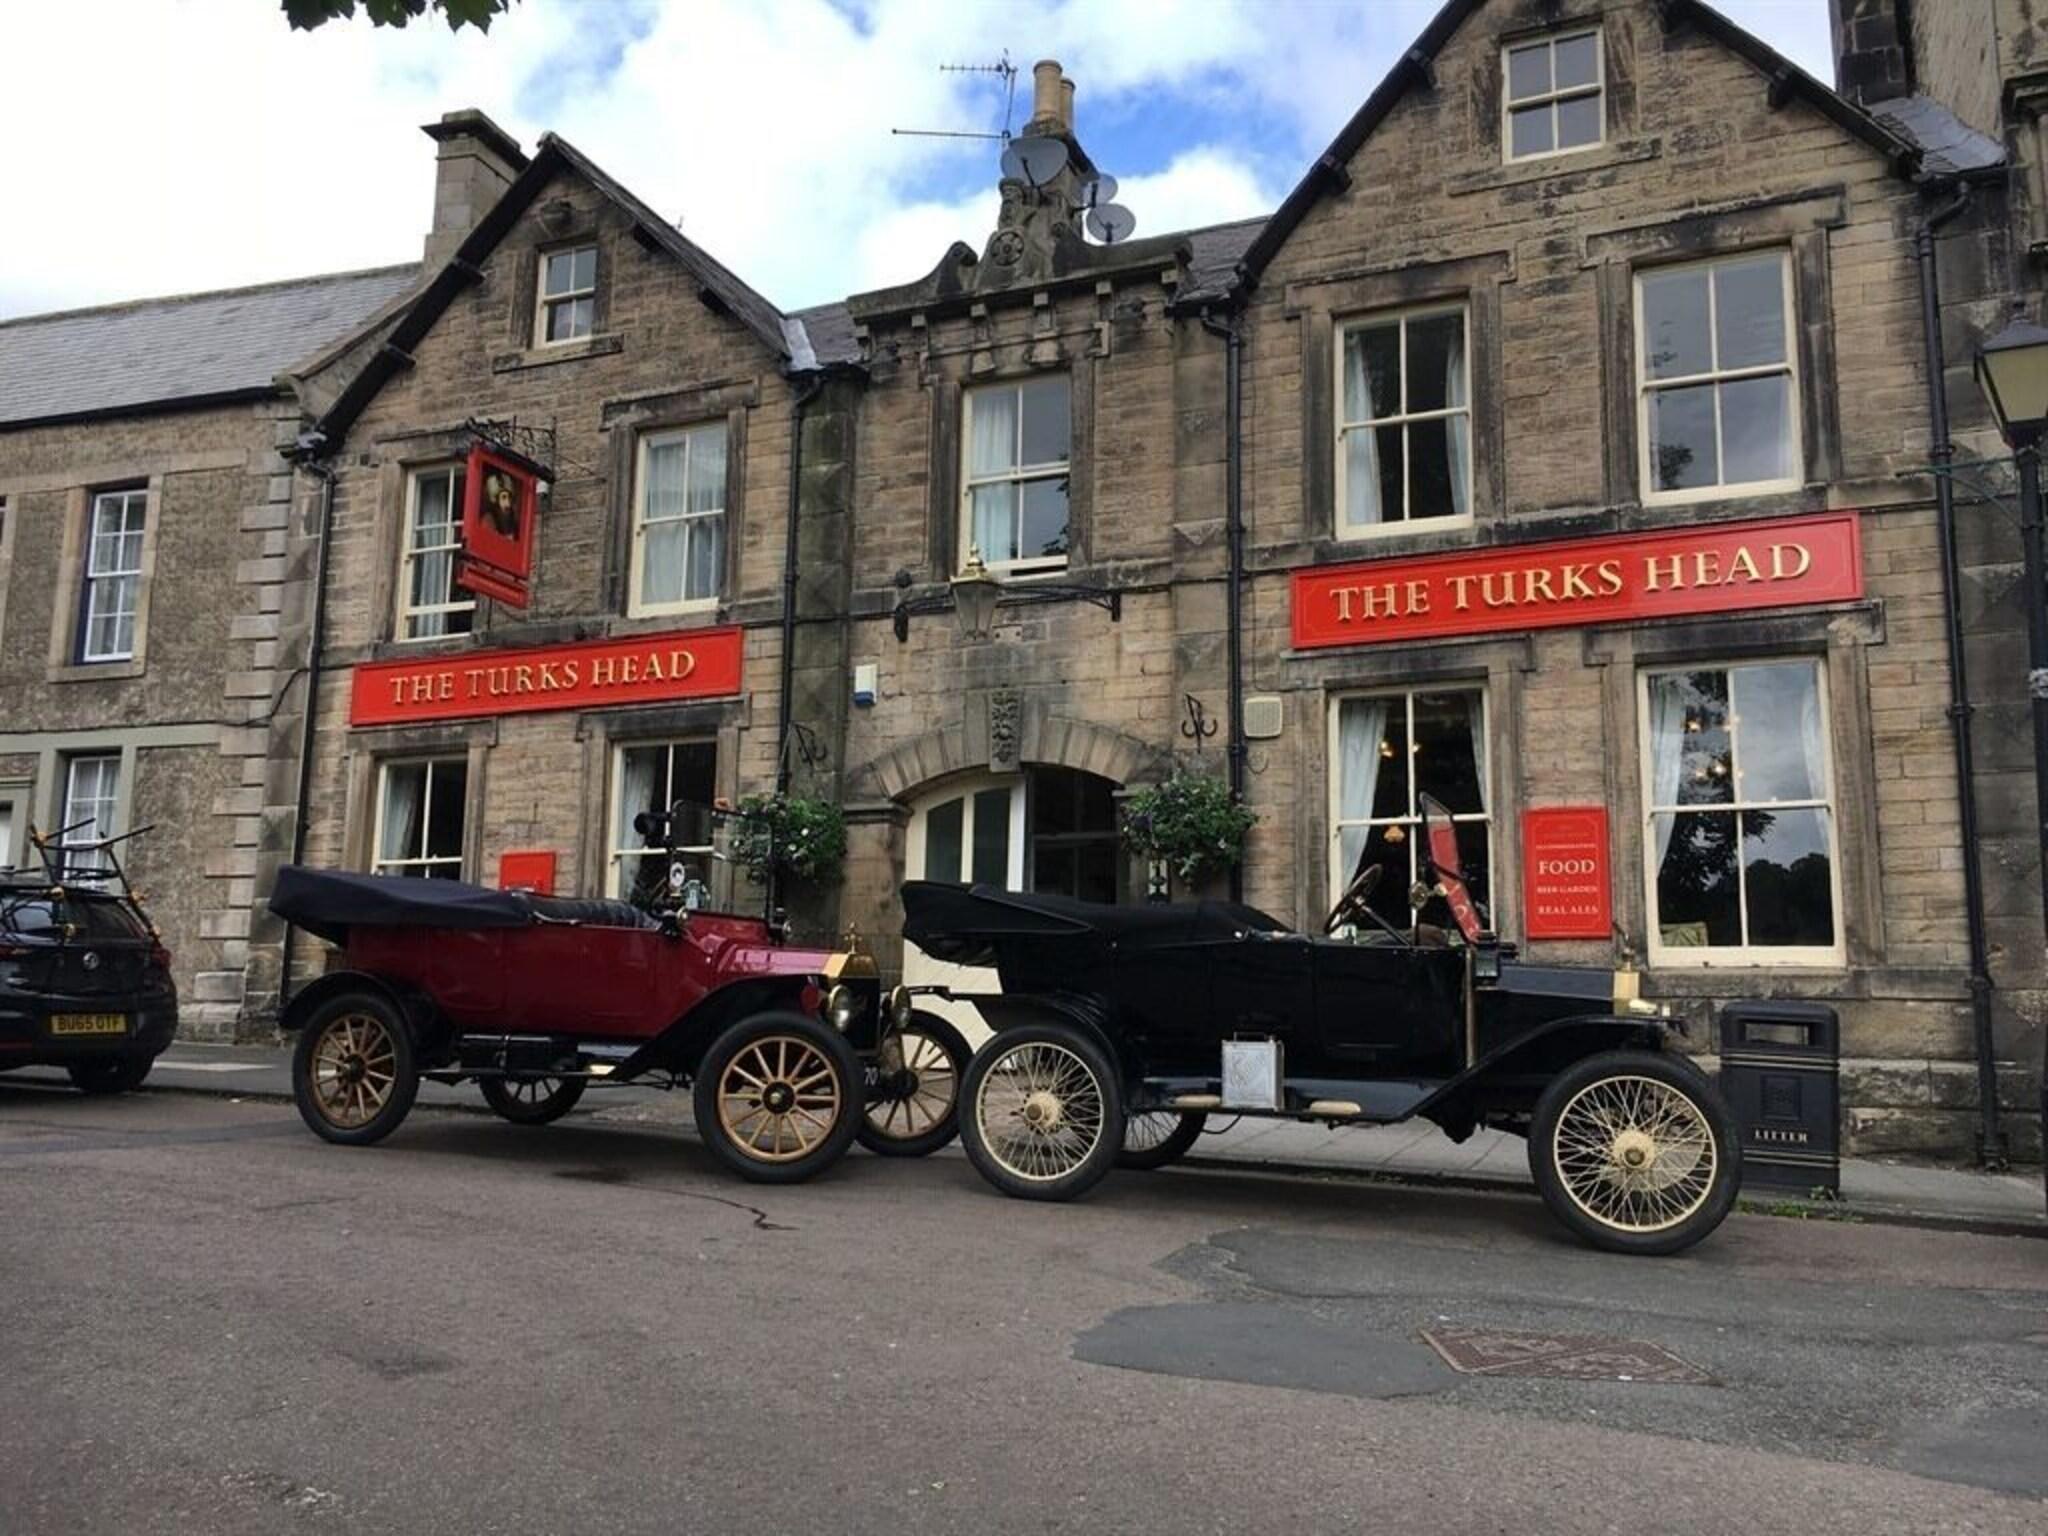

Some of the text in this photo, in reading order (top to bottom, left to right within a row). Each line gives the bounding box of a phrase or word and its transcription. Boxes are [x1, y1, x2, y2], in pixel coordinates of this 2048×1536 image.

[1329, 542, 1811, 622] THE TURKS HEAD
[390, 650, 696, 704] THE TURKS HEAD
[1538, 859, 1596, 875] FOOD
[1755, 1129, 1808, 1143] LITTER
